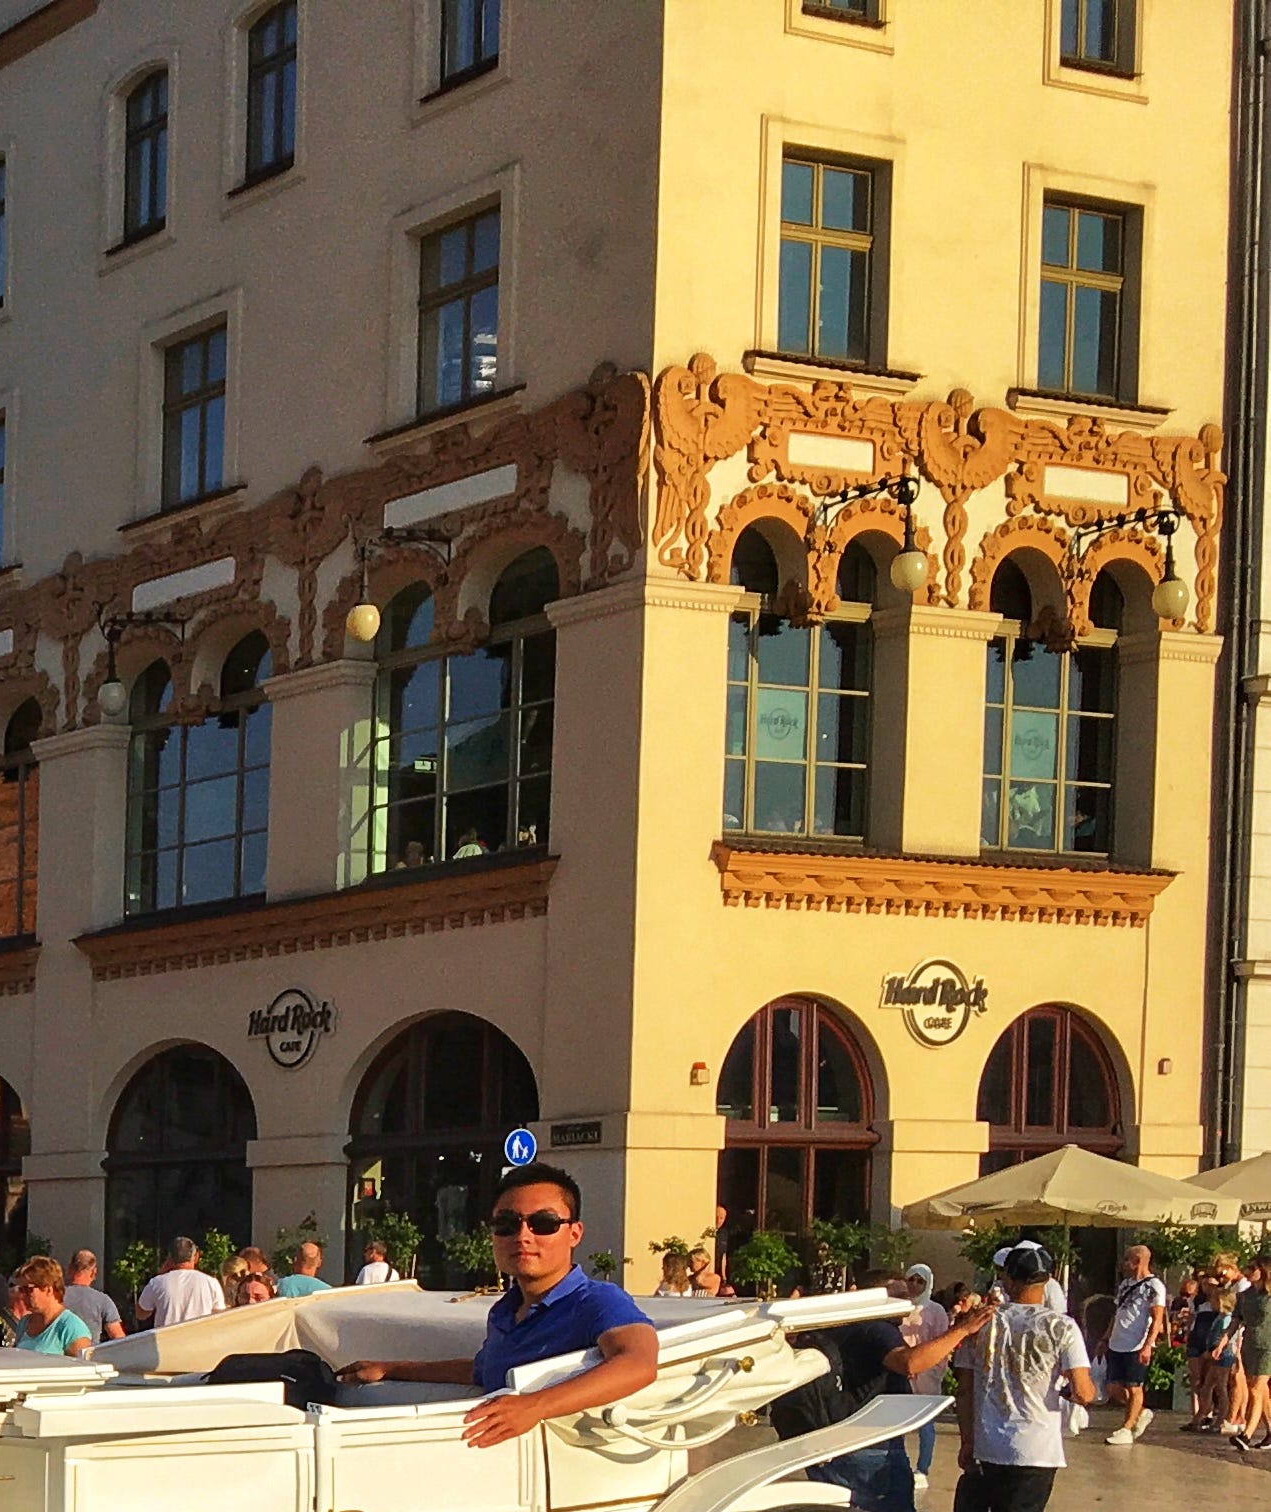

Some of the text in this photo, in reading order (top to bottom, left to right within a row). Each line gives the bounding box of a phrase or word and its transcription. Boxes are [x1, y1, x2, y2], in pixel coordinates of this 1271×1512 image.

[884, 976, 989, 1014] Hard Rock
[248, 1001, 332, 1036] Hard Rock
[923, 1016, 953, 1030] CAFE
[279, 1040, 302, 1053] CAFE
